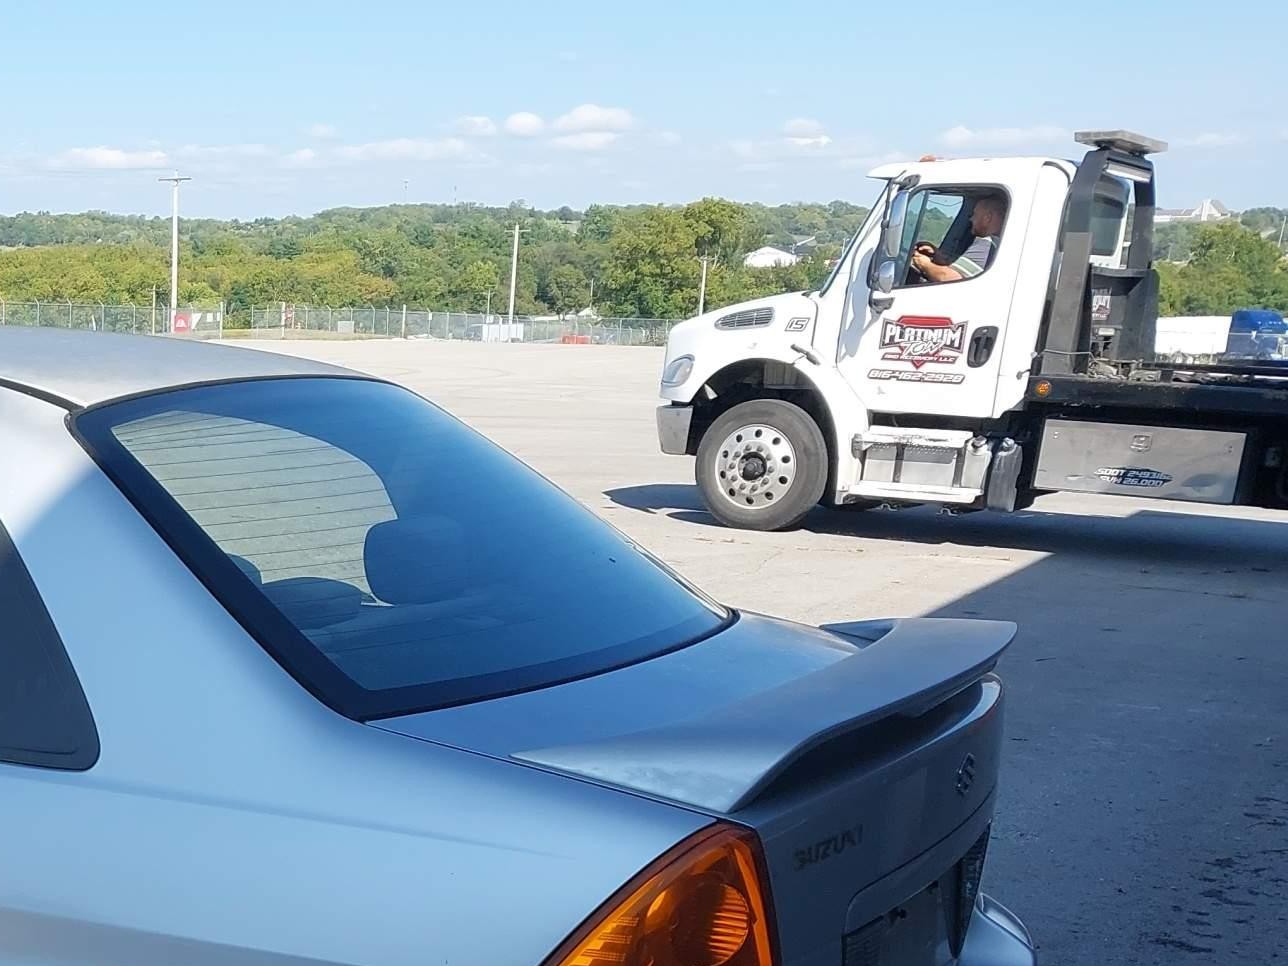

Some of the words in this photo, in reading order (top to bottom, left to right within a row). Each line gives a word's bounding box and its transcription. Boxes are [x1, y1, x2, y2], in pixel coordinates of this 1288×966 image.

[884, 323, 963, 349] PLATINUM
[899, 340, 945, 357] TOW
[793, 824, 864, 872] SUZUKI
